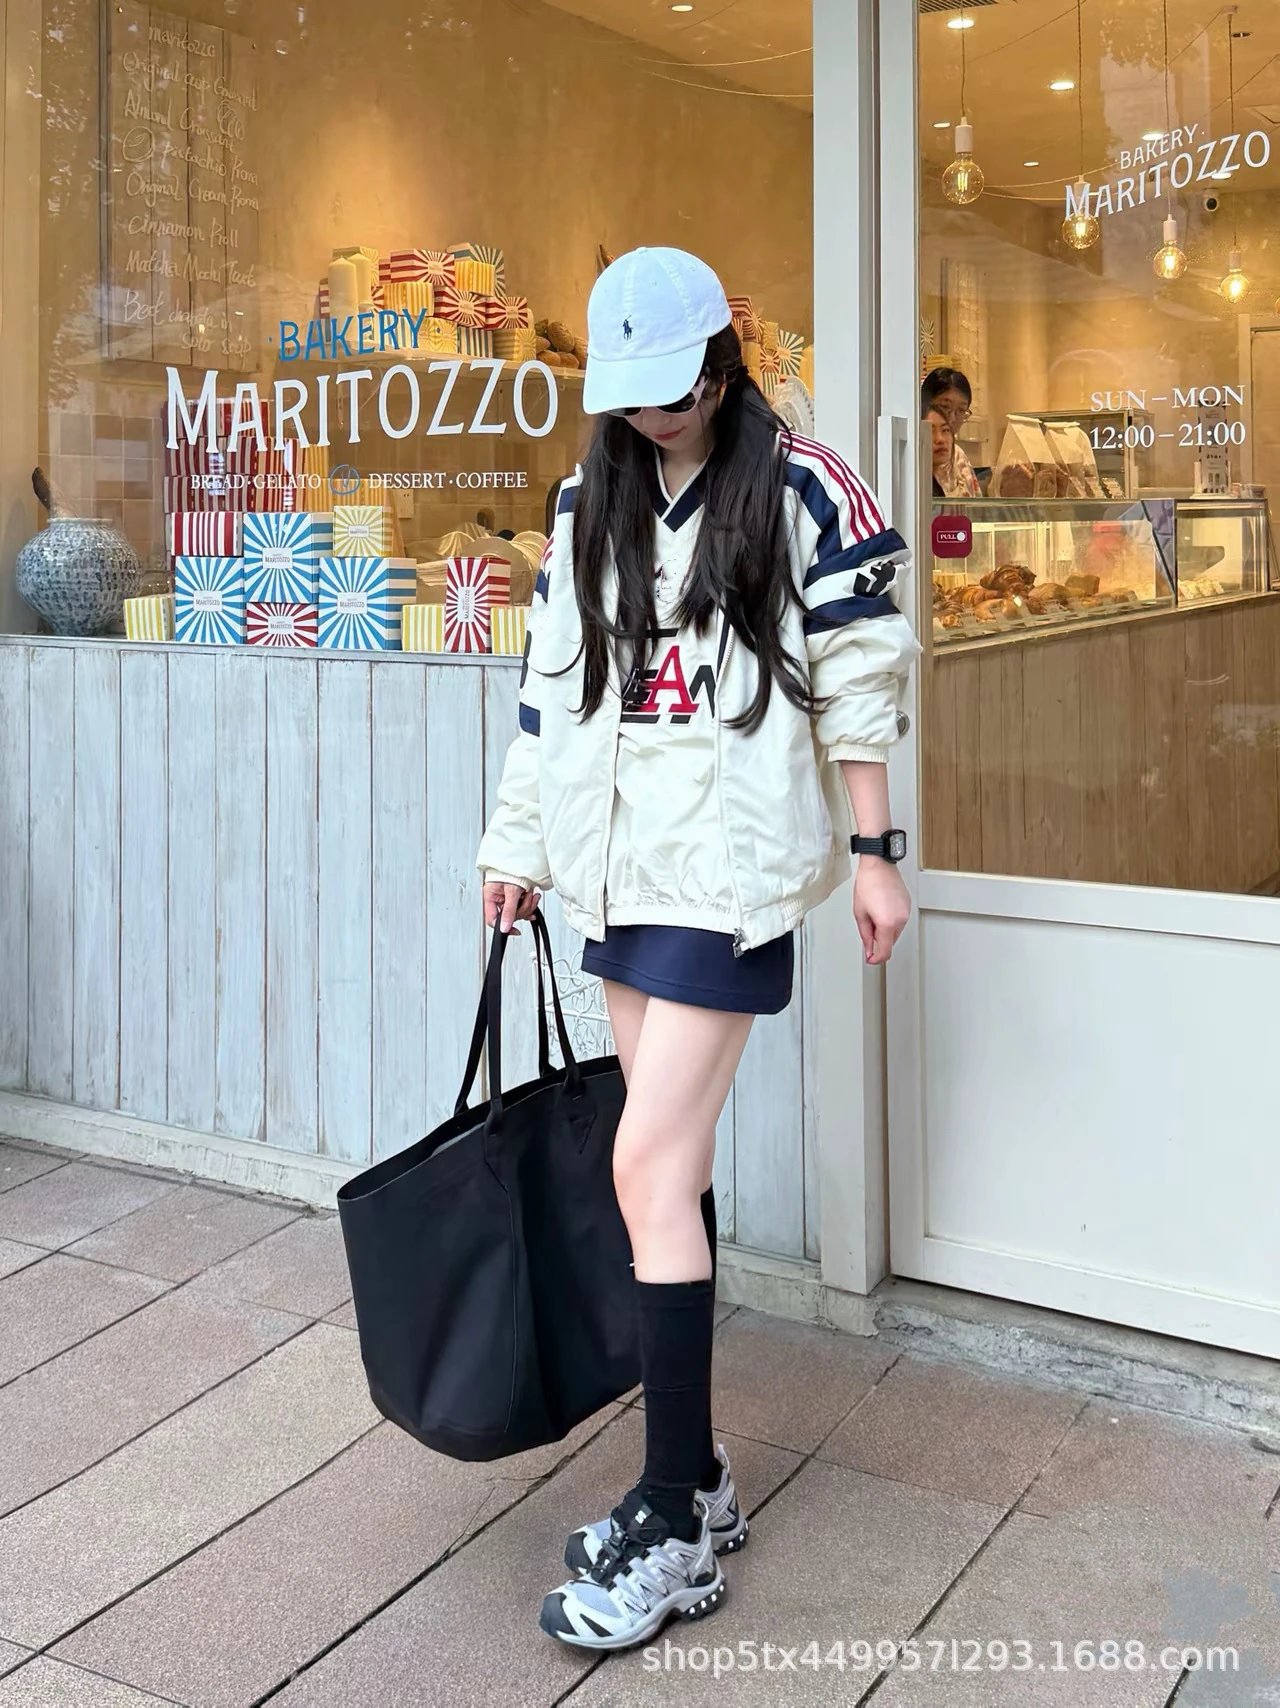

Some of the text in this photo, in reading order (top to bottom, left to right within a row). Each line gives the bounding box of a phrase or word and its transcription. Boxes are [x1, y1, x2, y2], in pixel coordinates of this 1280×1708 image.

[123, 51, 181, 92] Original
[124, 88, 174, 131] Almond
[1120, 123, 1199, 170] BAKERY
[126, 171, 184, 207] Original
[189, 178, 228, 206] Cream
[1065, 131, 1270, 220] MARITOZZO
[128, 214, 238, 248] Cinnamon Roll
[279, 308, 428, 362] BAKERY
[165, 358, 560, 454] MARITOZZO
[1091, 389, 1147, 412] SUN
[1172, 385, 1246, 409] MON
[1089, 425, 1155, 450] 12:00
[1178, 421, 1246, 447] 21:00
